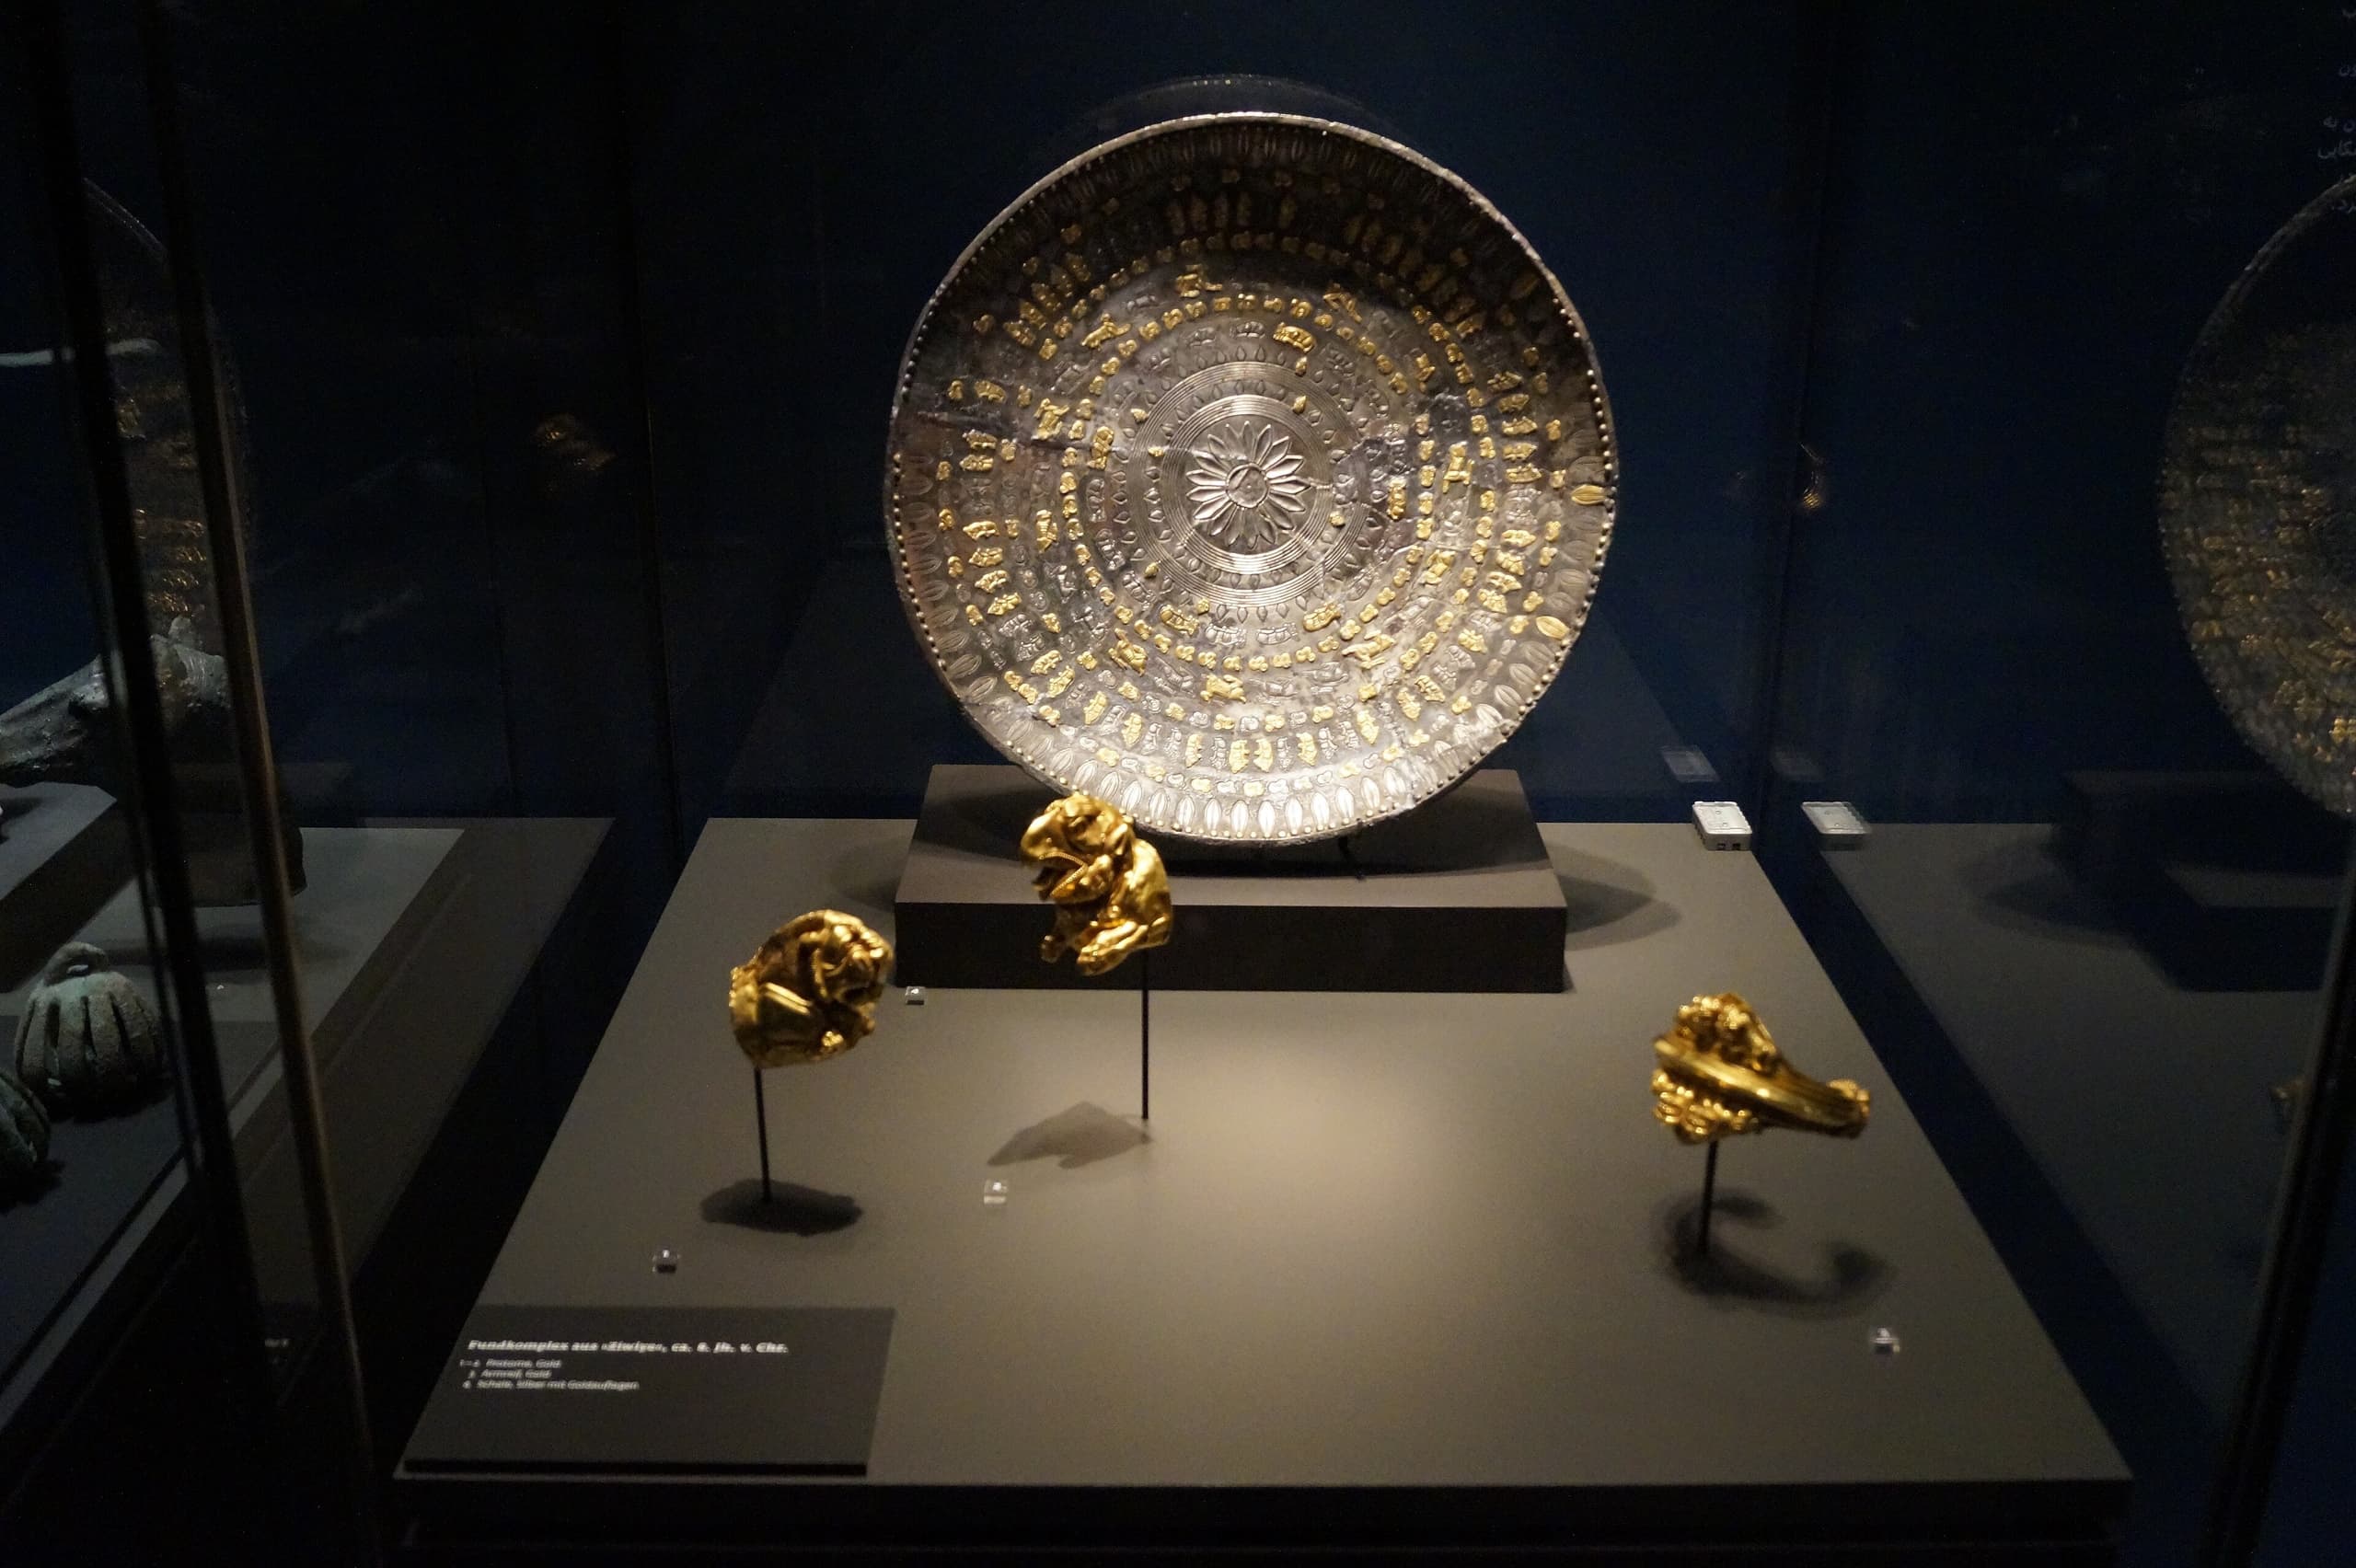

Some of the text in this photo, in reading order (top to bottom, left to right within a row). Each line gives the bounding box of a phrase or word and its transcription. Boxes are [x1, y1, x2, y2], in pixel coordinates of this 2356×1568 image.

[468, 1340, 569, 1352] Fundkomplex
[571, 1342, 598, 1351] aus
[756, 1342, 789, 1354] Chr.
